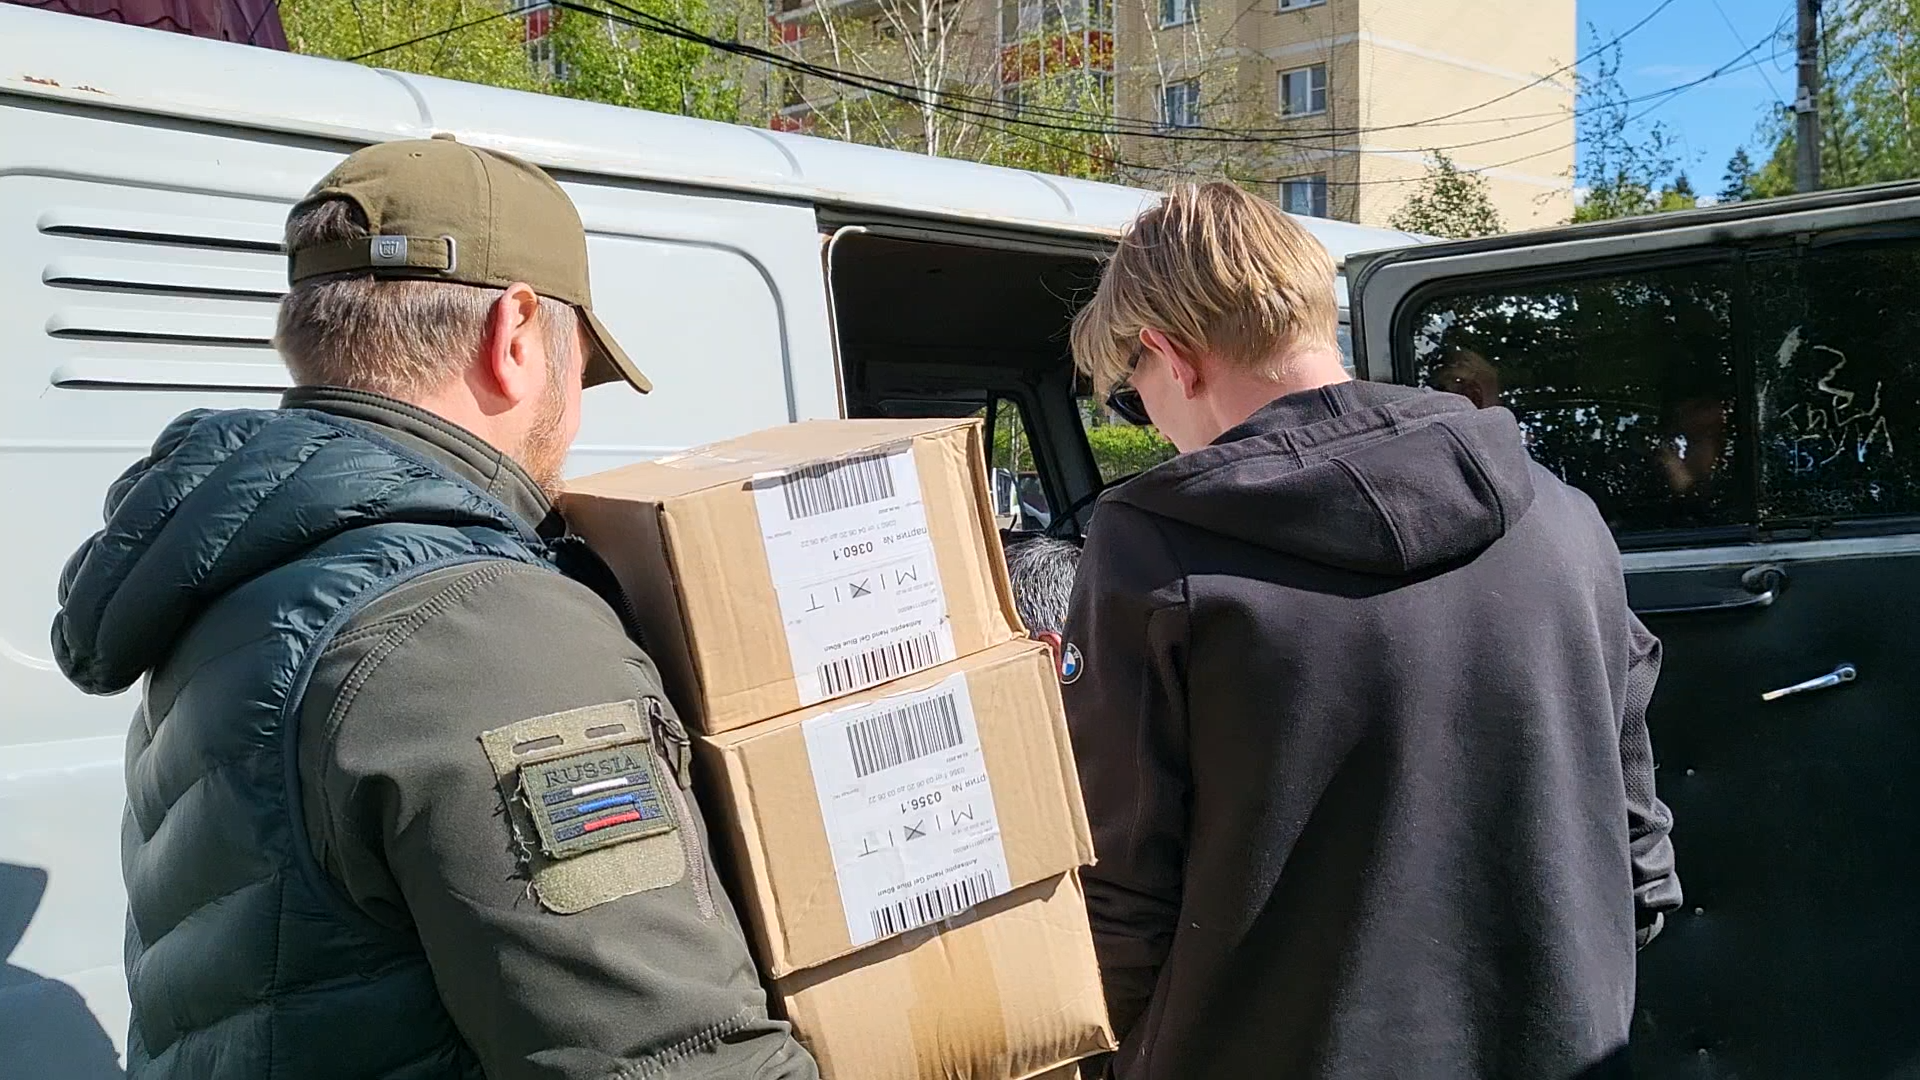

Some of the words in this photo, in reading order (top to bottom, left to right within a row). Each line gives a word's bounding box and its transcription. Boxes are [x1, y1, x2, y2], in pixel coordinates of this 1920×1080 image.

[883, 535, 894, 545] №
[896, 527, 927, 541] партия
[833, 541, 873, 560] 0360.1
[805, 564, 917, 612] MIXIT
[890, 619, 922, 635] Antiseptic
[859, 633, 871, 643] Gel
[872, 629, 889, 639] Hand
[843, 638, 858, 648] Blue
[543, 754, 641, 788] RUSSIA
[951, 782, 963, 793] №
[901, 791, 942, 814] 0356.1
[858, 803, 974, 858] MIXIT
[945, 858, 977, 874] Antiseptic
[914, 876, 925, 886] Gel
[926, 869, 944, 881] Hand
[896, 881, 913, 891] Blue
